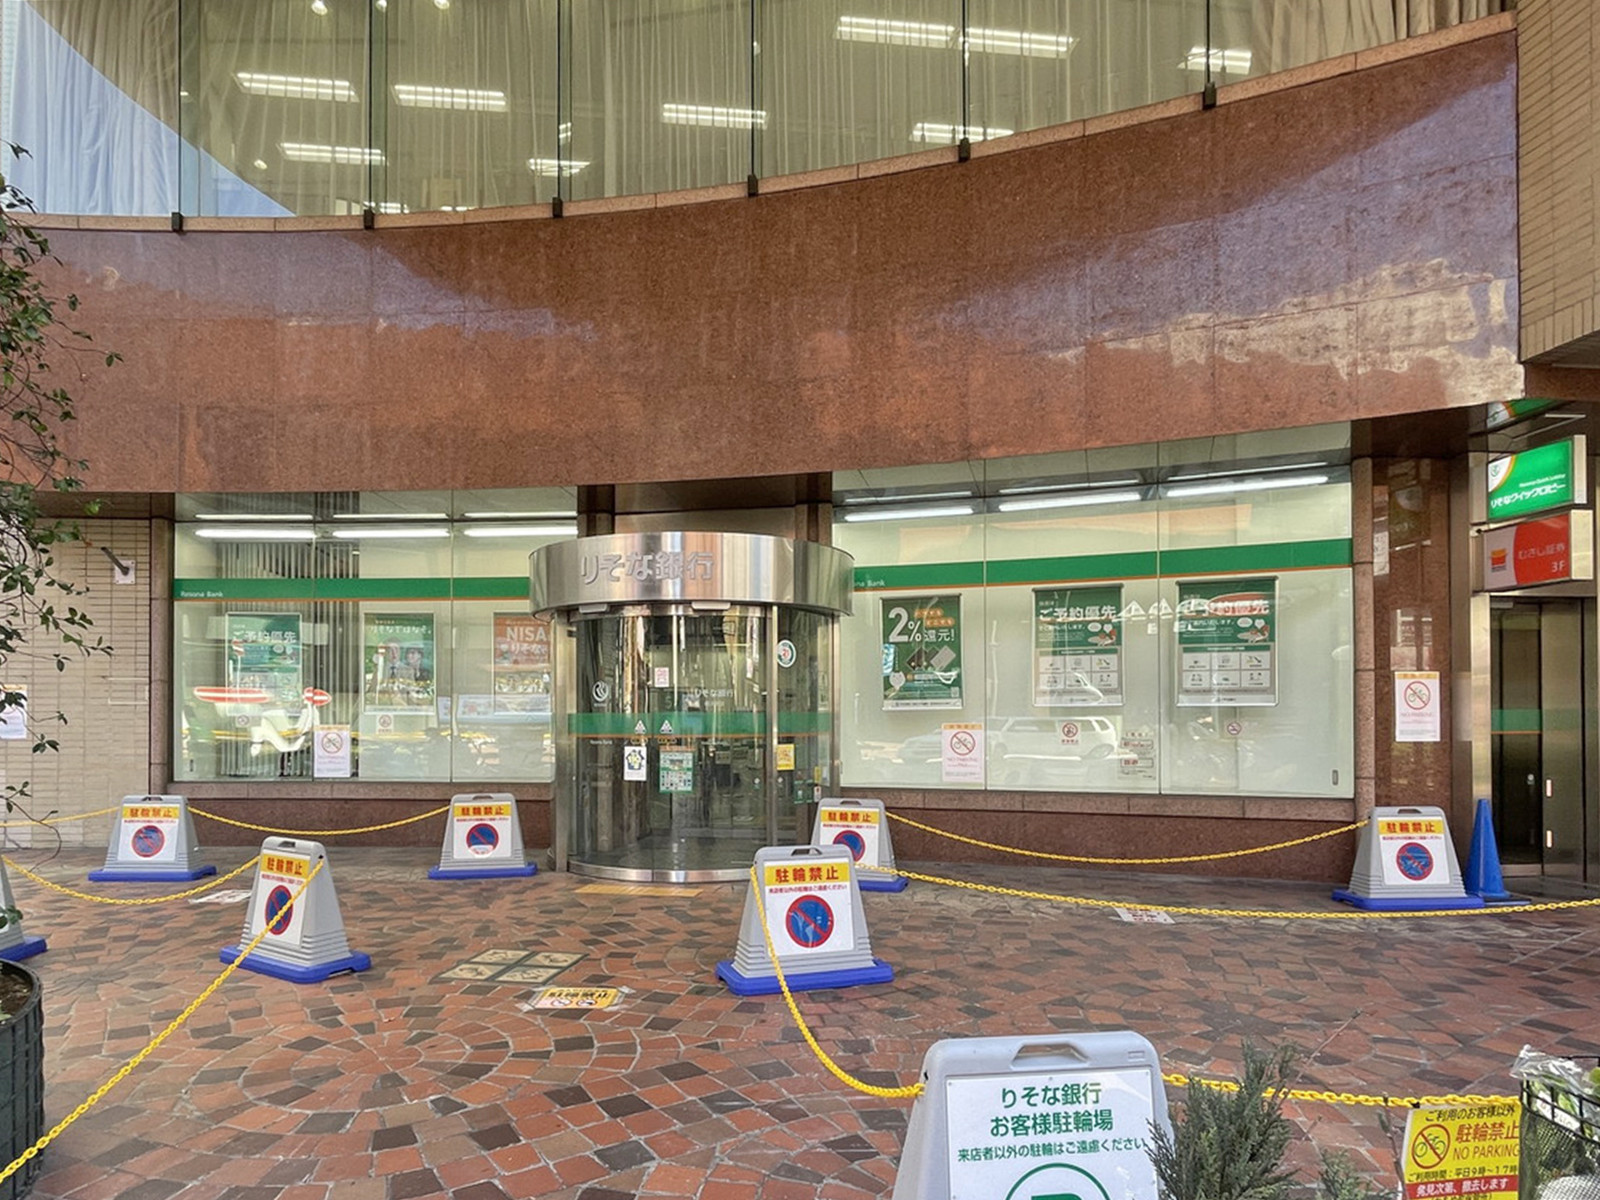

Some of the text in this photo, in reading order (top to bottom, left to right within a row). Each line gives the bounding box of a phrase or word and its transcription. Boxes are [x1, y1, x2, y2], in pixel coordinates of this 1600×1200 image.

[1490, 484, 1566, 508] りそなクイックロビー
[580, 552, 715, 585] りそな銀行
[1551, 560, 1566, 573] 3F
[506, 626, 548, 641] NISA
[828, 811, 872, 823] 駐輪禁止
[1386, 822, 1435, 833] 駐輪禁止
[775, 865, 839, 884] 駐輪禁止
[1001, 1081, 1102, 1109] りそな銀行
[990, 1109, 1114, 1138] お客様駐輪場
[1456, 1120, 1520, 1144] 駐輪禁止
[957, 1137, 1147, 1163] 来店者以外の駐輪はご遠慮ください
[1453, 1143, 1520, 1160] NO PARKING
